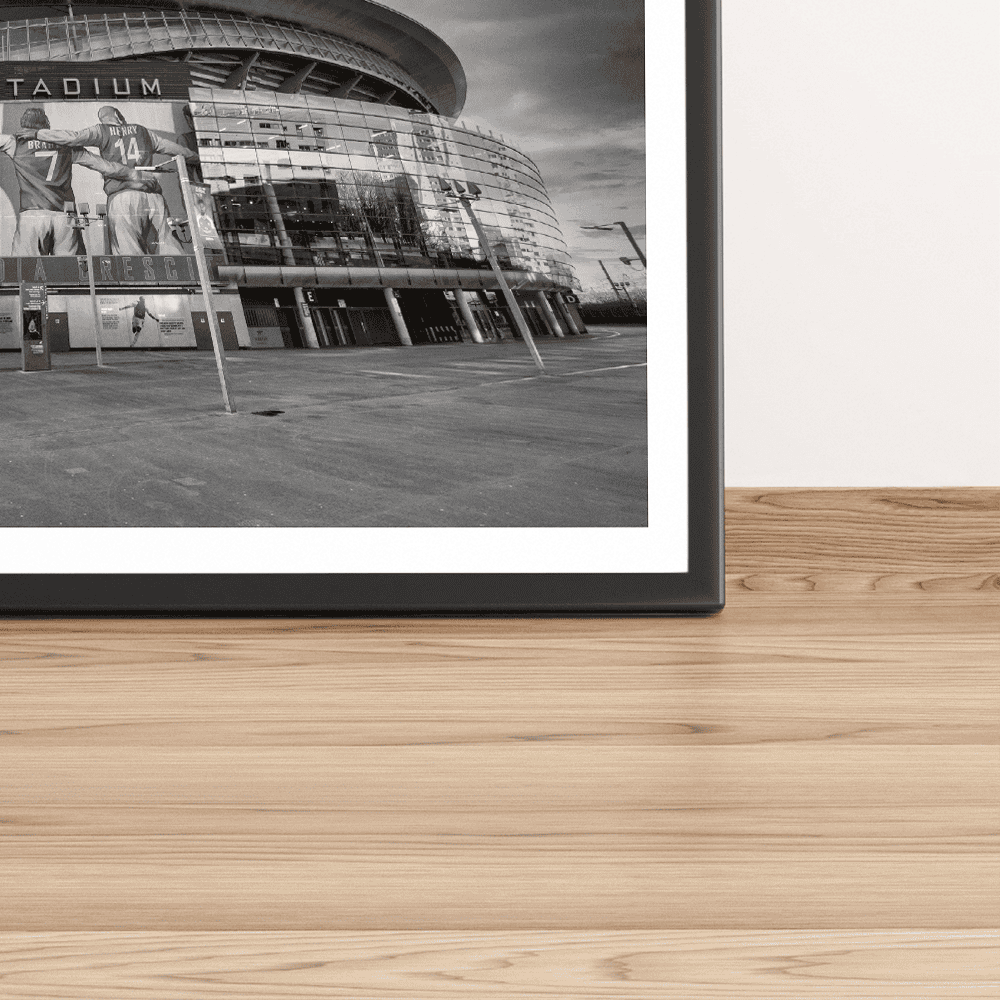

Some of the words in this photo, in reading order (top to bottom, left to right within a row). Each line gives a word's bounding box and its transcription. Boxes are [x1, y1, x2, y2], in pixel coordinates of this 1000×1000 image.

[109, 125, 137, 136] HENRY
[115, 137, 141, 165] 14
[34, 151, 58, 181] 7
